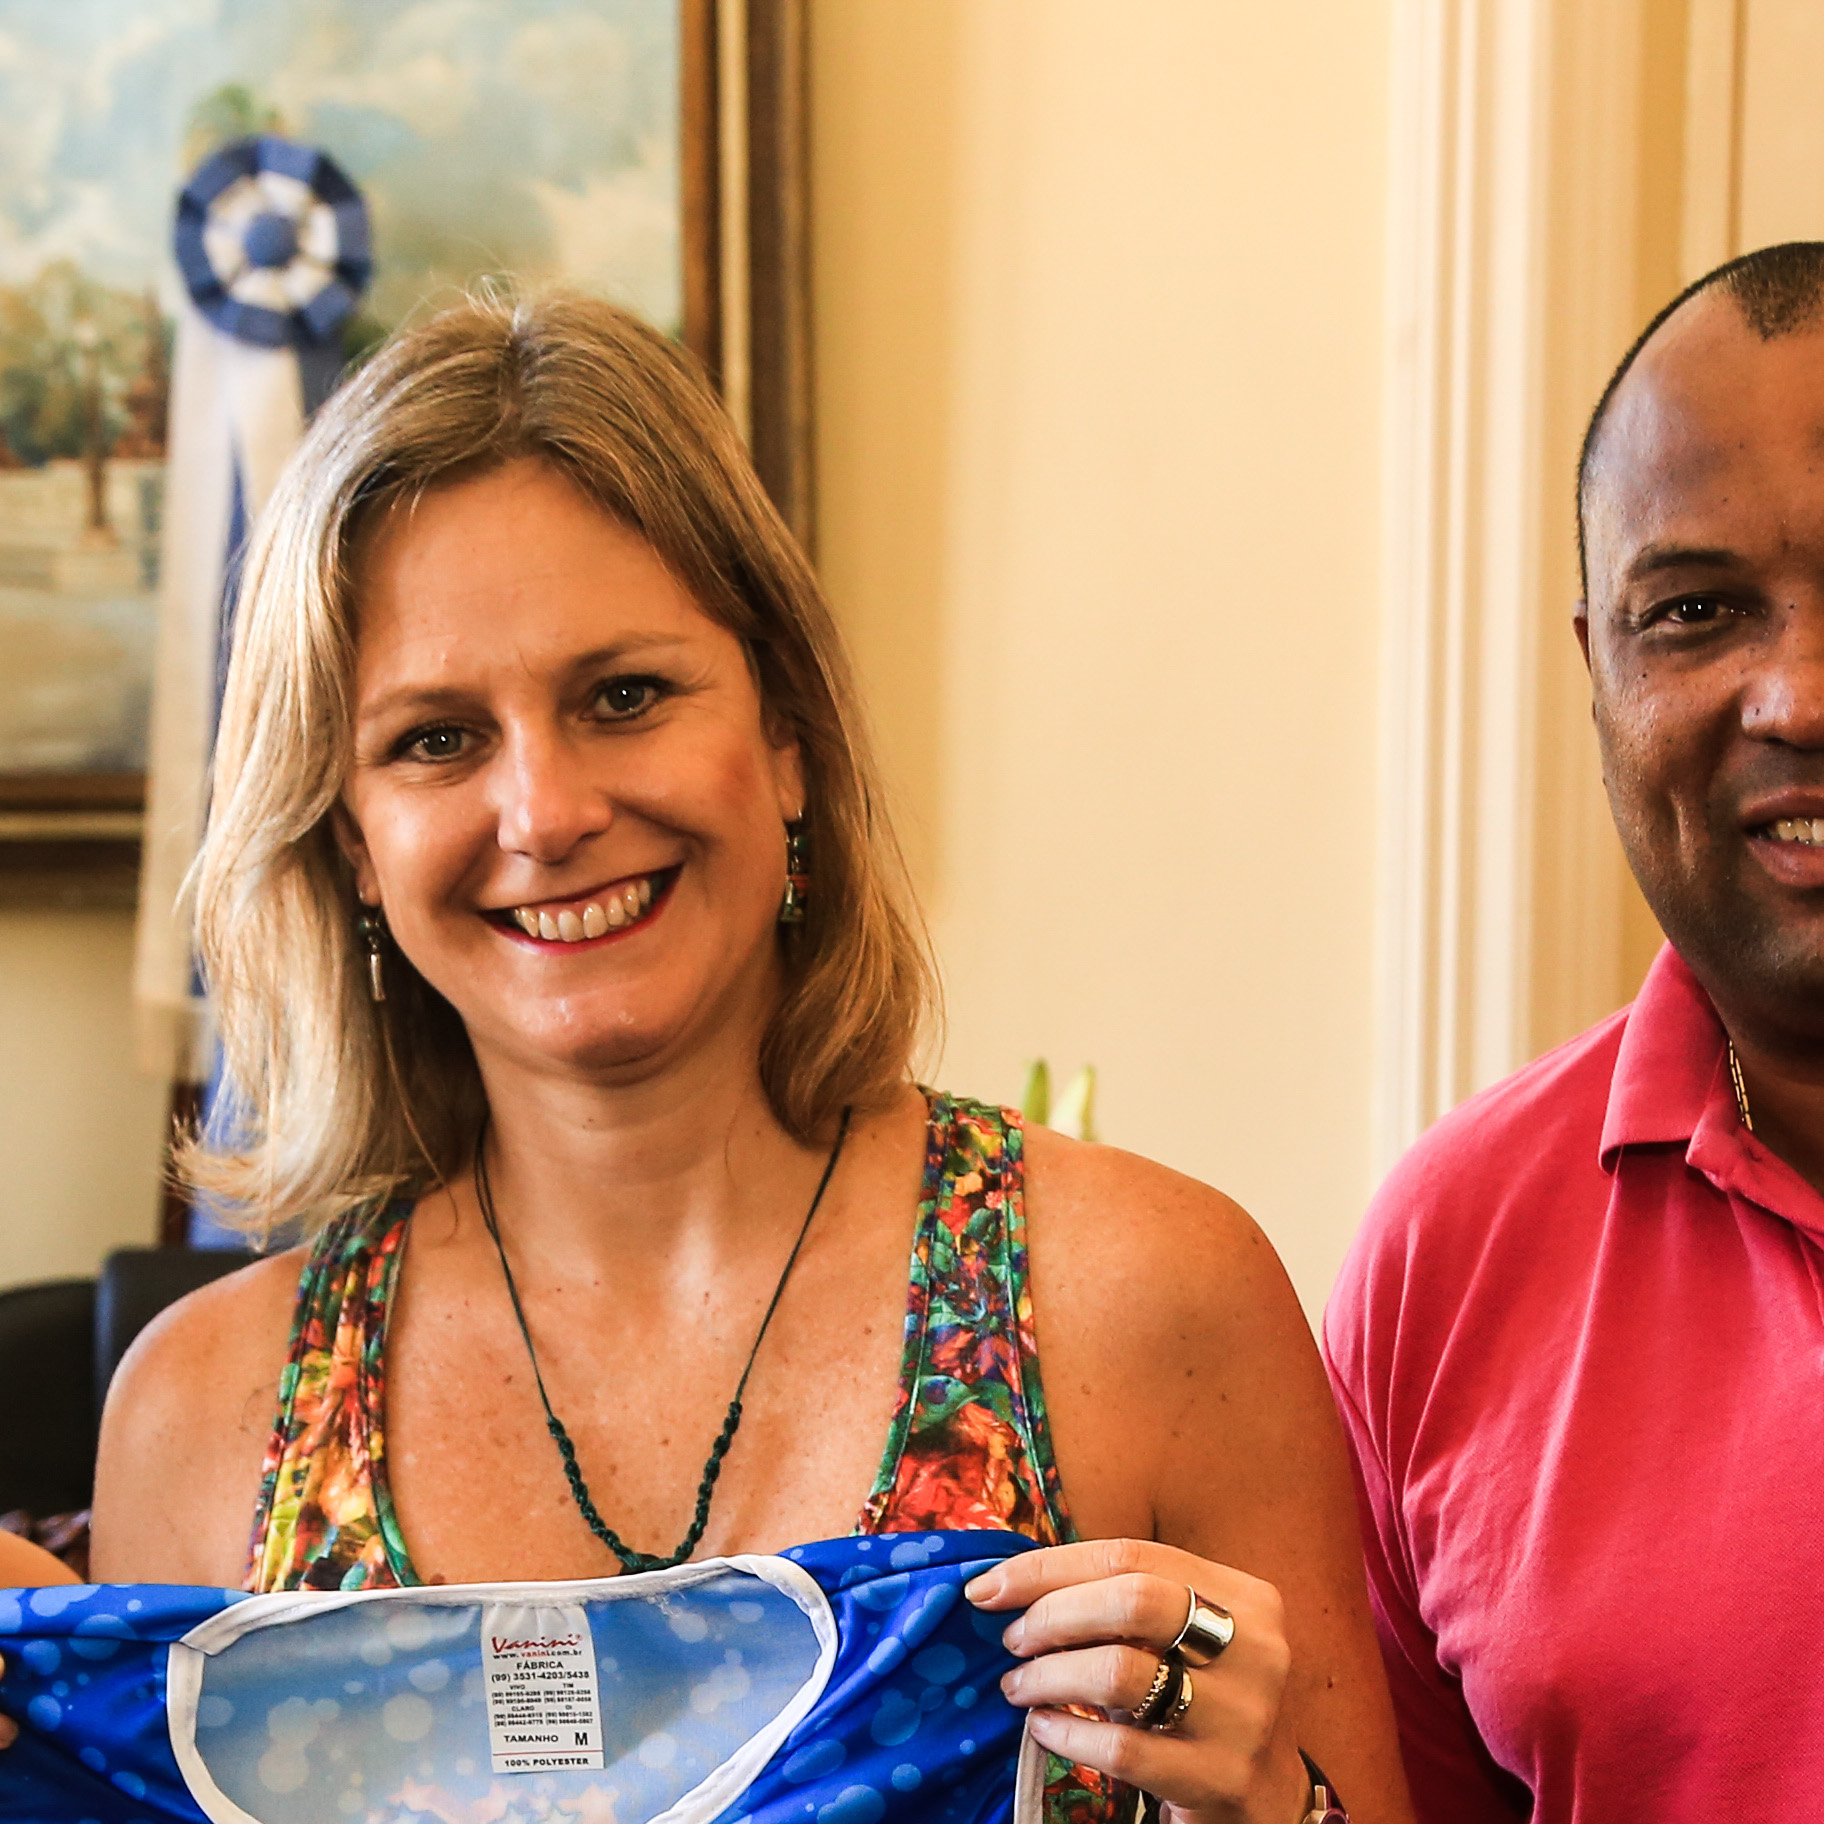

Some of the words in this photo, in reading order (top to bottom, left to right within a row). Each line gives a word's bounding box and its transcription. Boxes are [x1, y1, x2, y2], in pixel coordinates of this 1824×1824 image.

[516, 1660, 564, 1670] FÁBRICA
[503, 1734, 559, 1743] TAMANHO
[574, 1732, 588, 1746] M
[504, 1759, 530, 1767] 100%
[532, 1757, 590, 1766] POLYESTER
